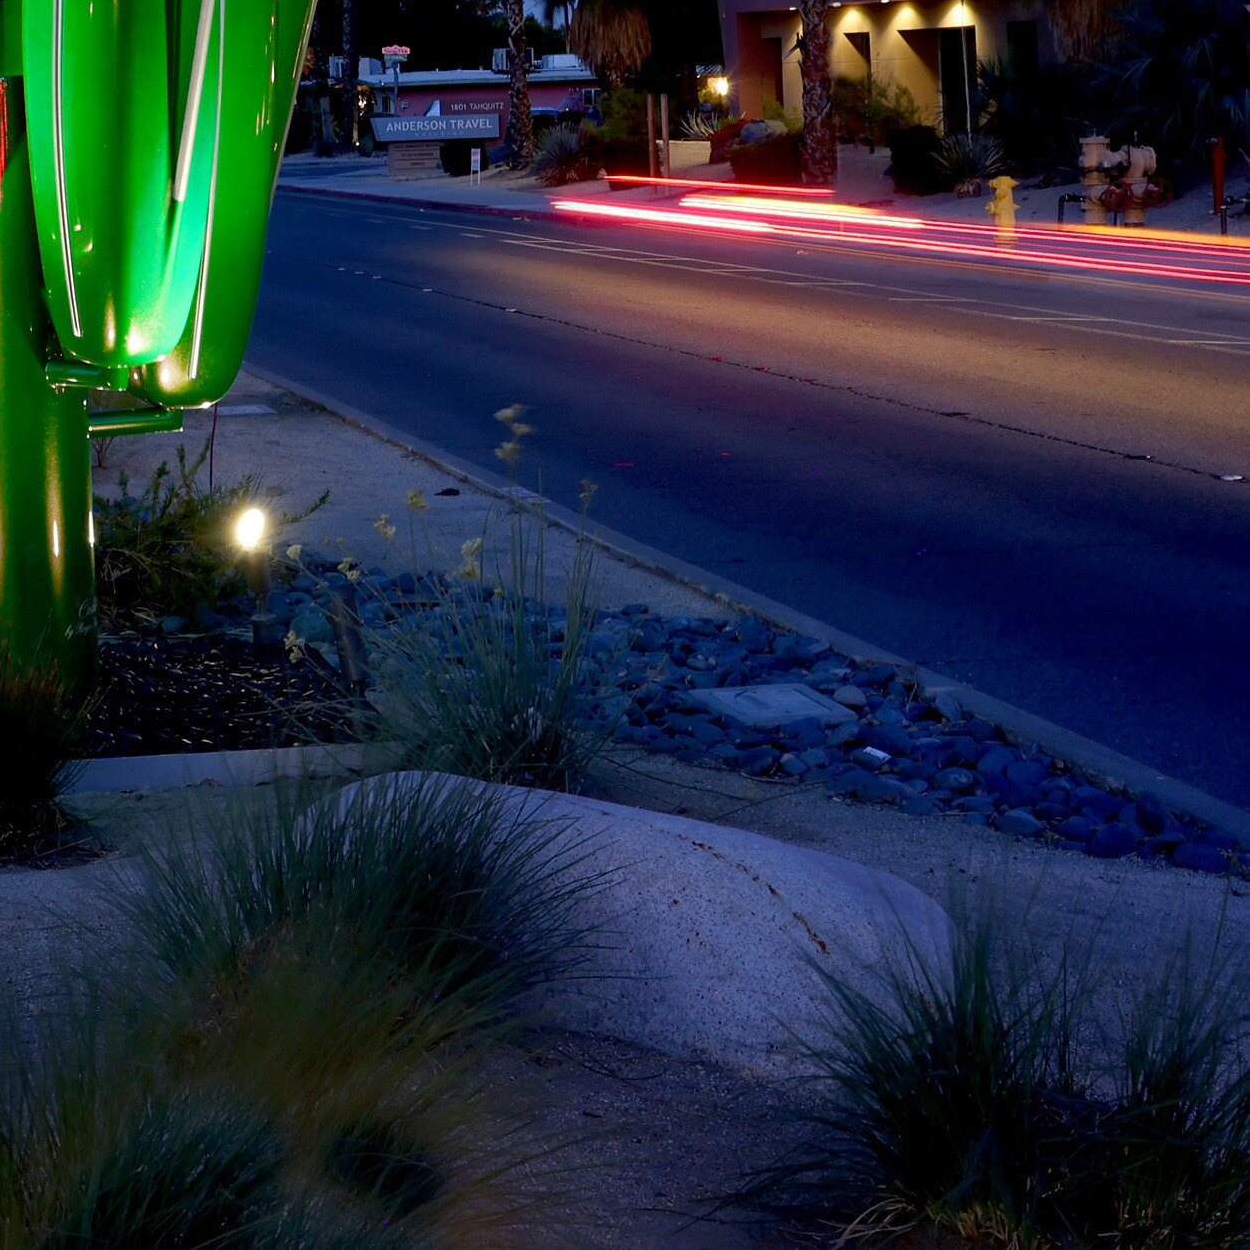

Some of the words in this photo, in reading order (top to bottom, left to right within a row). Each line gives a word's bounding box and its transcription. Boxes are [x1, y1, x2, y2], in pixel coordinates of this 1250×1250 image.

[450, 103, 467, 111] 1801
[469, 101, 505, 111] TAHQUITZ
[386, 120, 447, 132] ANDERSON
[449, 118, 493, 130] TRAVEL
